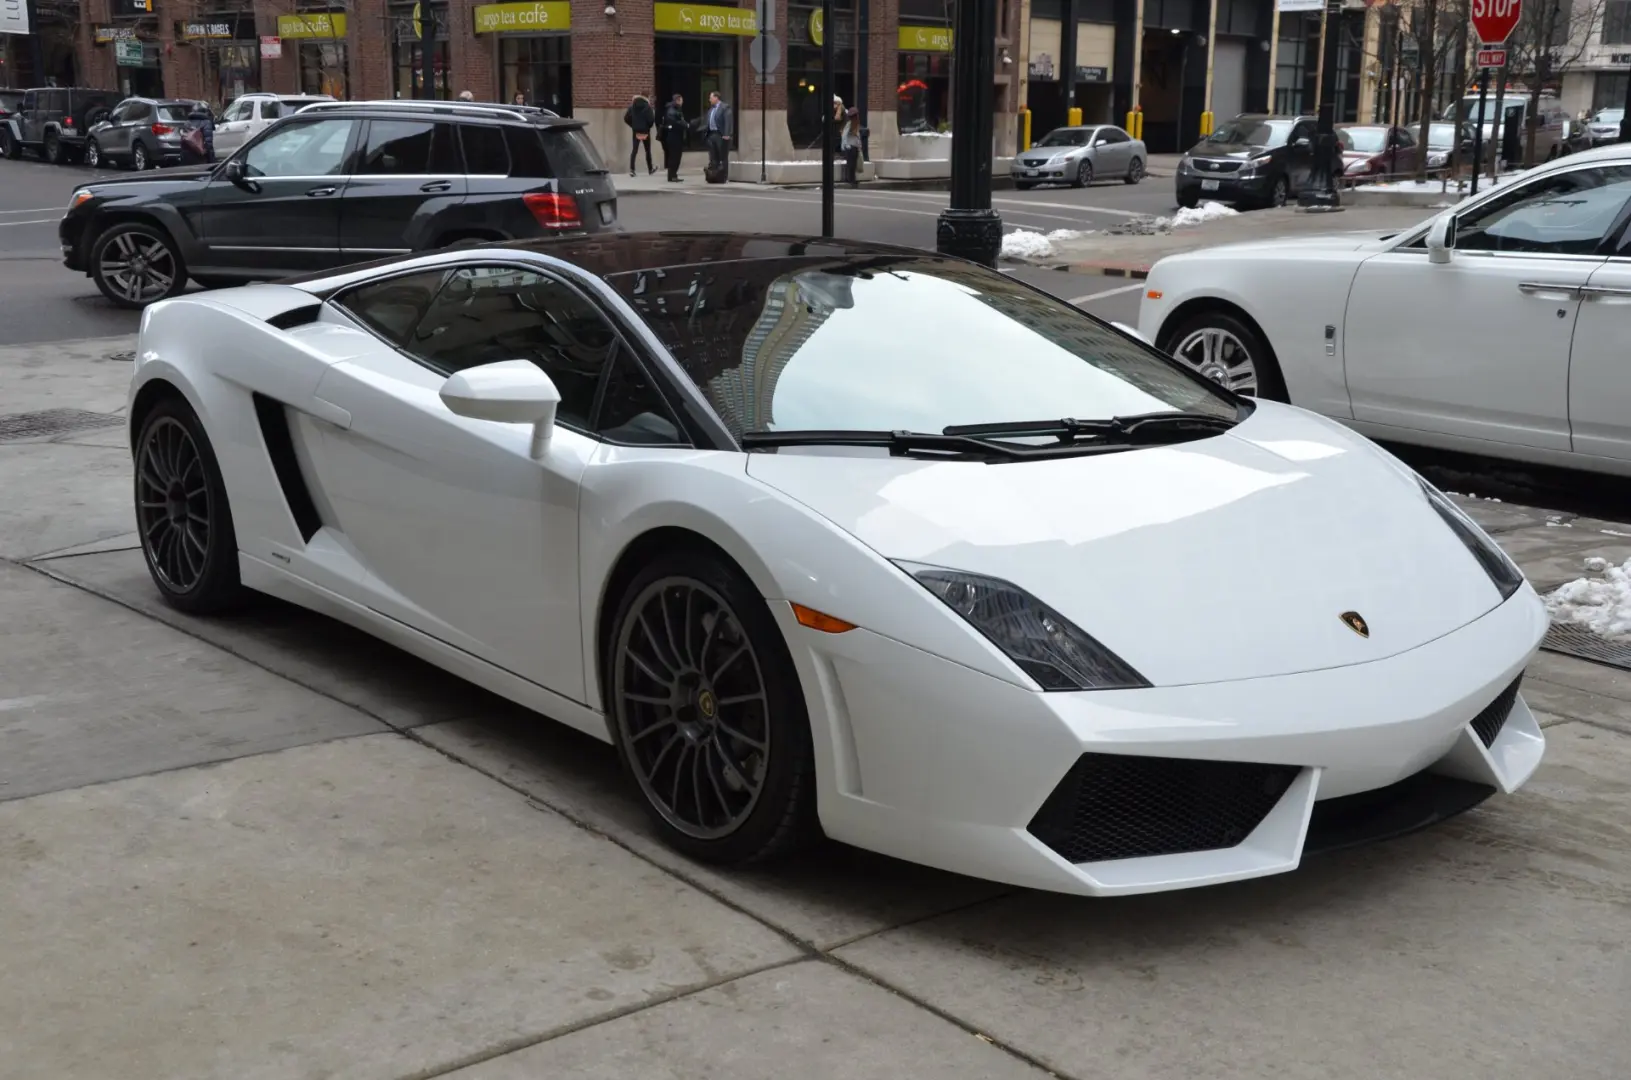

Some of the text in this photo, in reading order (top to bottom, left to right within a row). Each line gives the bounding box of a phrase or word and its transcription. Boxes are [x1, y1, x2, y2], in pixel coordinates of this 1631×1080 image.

[501, 10, 516, 24] tea
[518, 3, 549, 24] café
[1474, 0, 1519, 18] STOP
[699, 14, 726, 31] argo
[727, 13, 741, 28] tea
[1479, 53, 1504, 64] ALL WAY
